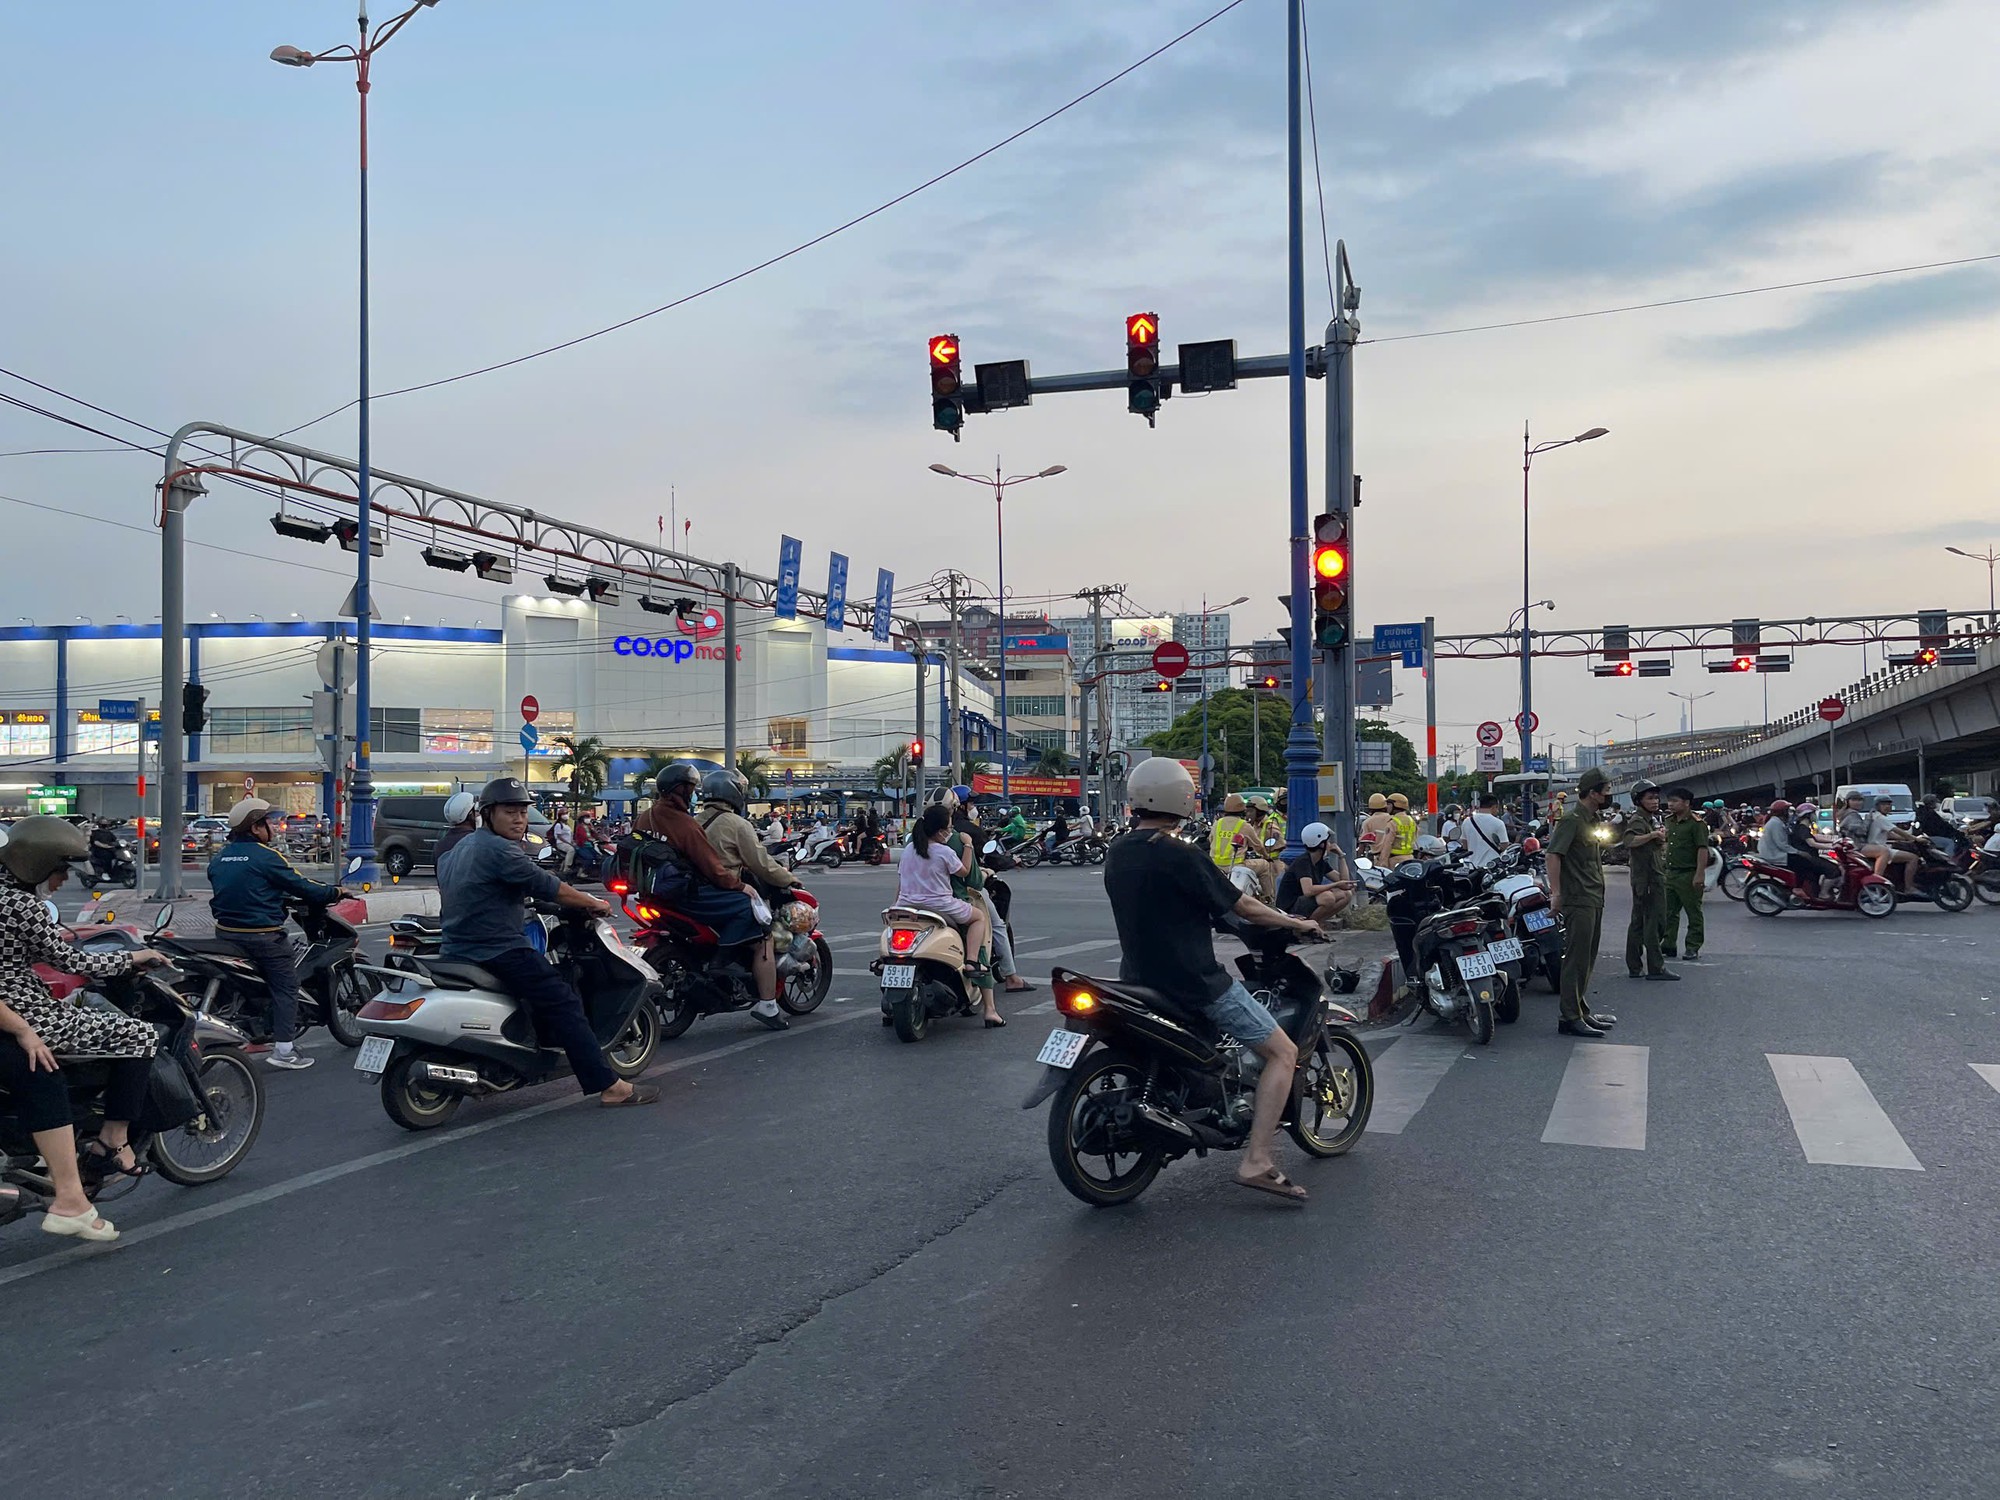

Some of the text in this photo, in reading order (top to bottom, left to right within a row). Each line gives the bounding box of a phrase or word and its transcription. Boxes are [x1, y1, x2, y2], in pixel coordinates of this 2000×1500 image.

[1384, 628, 1413, 636] ĐƯỜNG
[1118, 638, 1147, 647] co.op
[613, 636, 742, 664] co.op mat
[1462, 955, 1487, 967] 77-E1
[887, 966, 910, 976] 59-V1
[1462, 964, 1494, 978] 753.80
[882, 977, 912, 987] 455.66
[1040, 1046, 1076, 1066] 113.83
